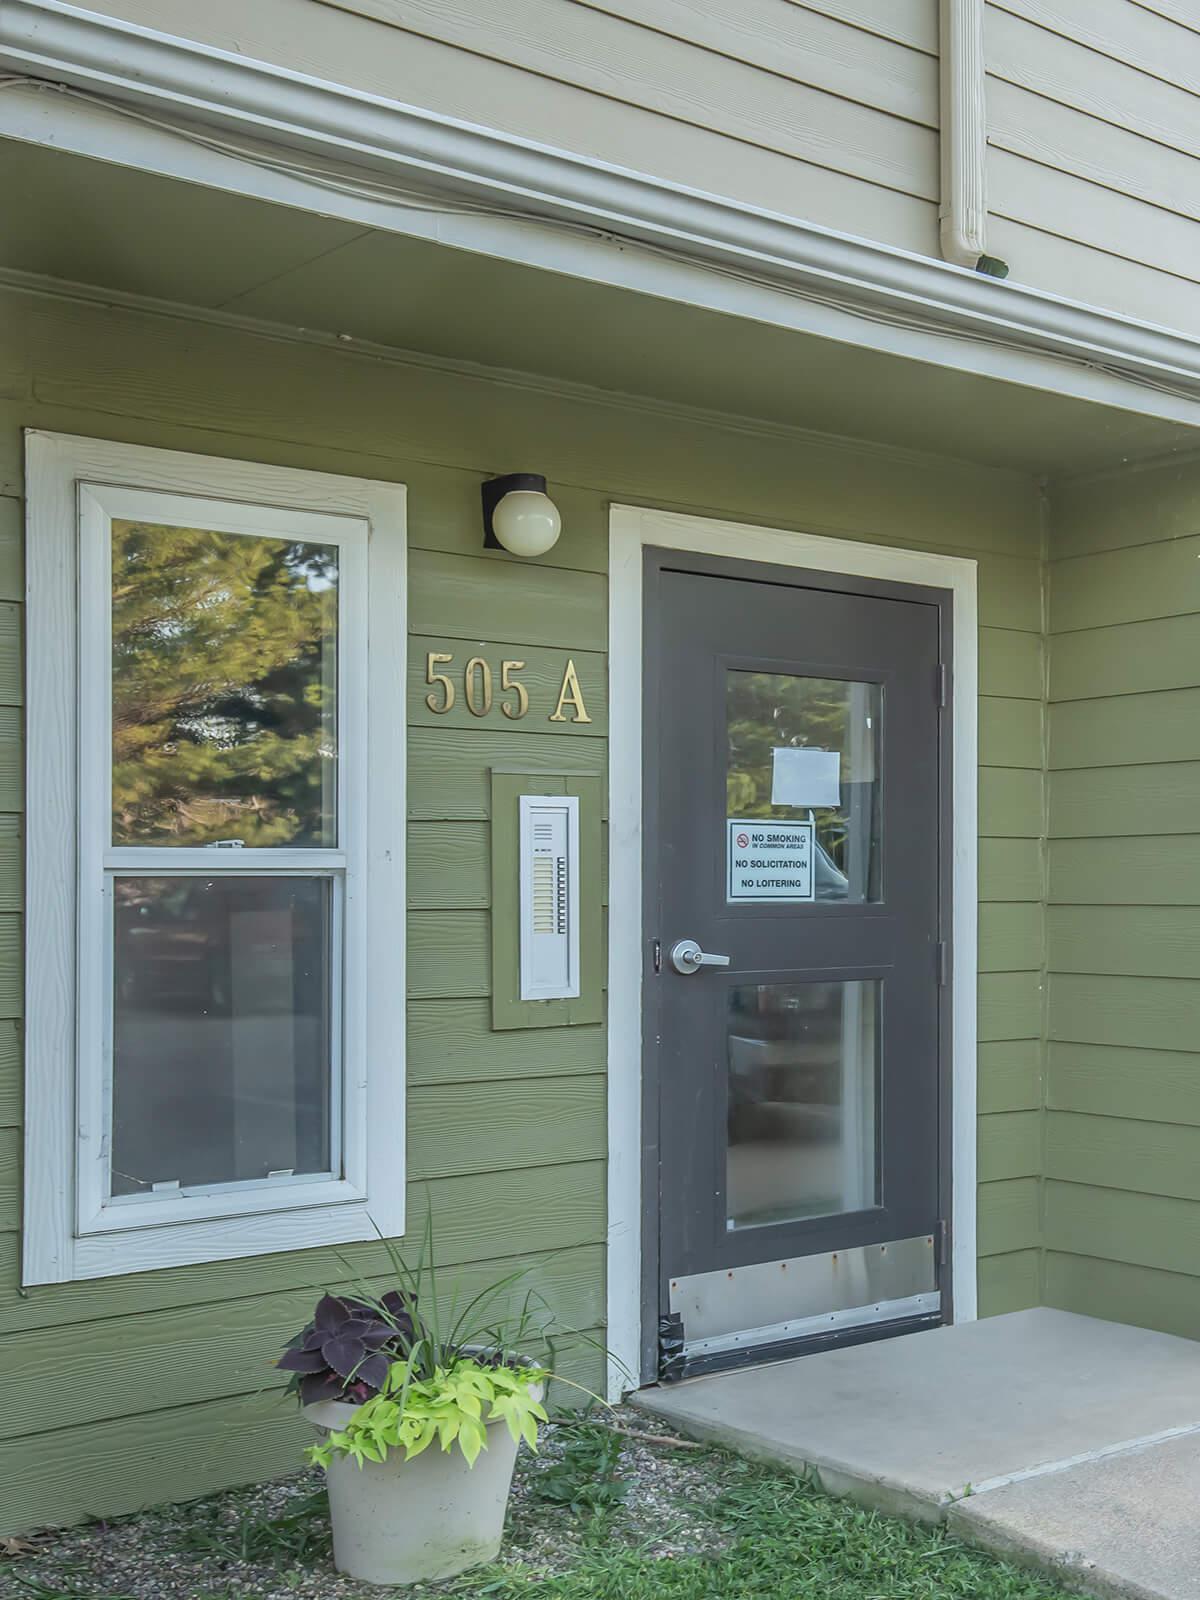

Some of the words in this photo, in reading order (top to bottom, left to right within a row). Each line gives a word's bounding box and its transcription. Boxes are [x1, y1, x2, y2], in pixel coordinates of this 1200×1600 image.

[426, 652, 529, 720] 505
[549, 659, 593, 723] A
[752, 834, 765, 842] NO
[767, 834, 806, 843] SMOKING
[736, 860, 748, 868] NO
[750, 860, 807, 868] SOLICITATION
[741, 879, 754, 888] NO
[756, 879, 801, 888] LOITERING
